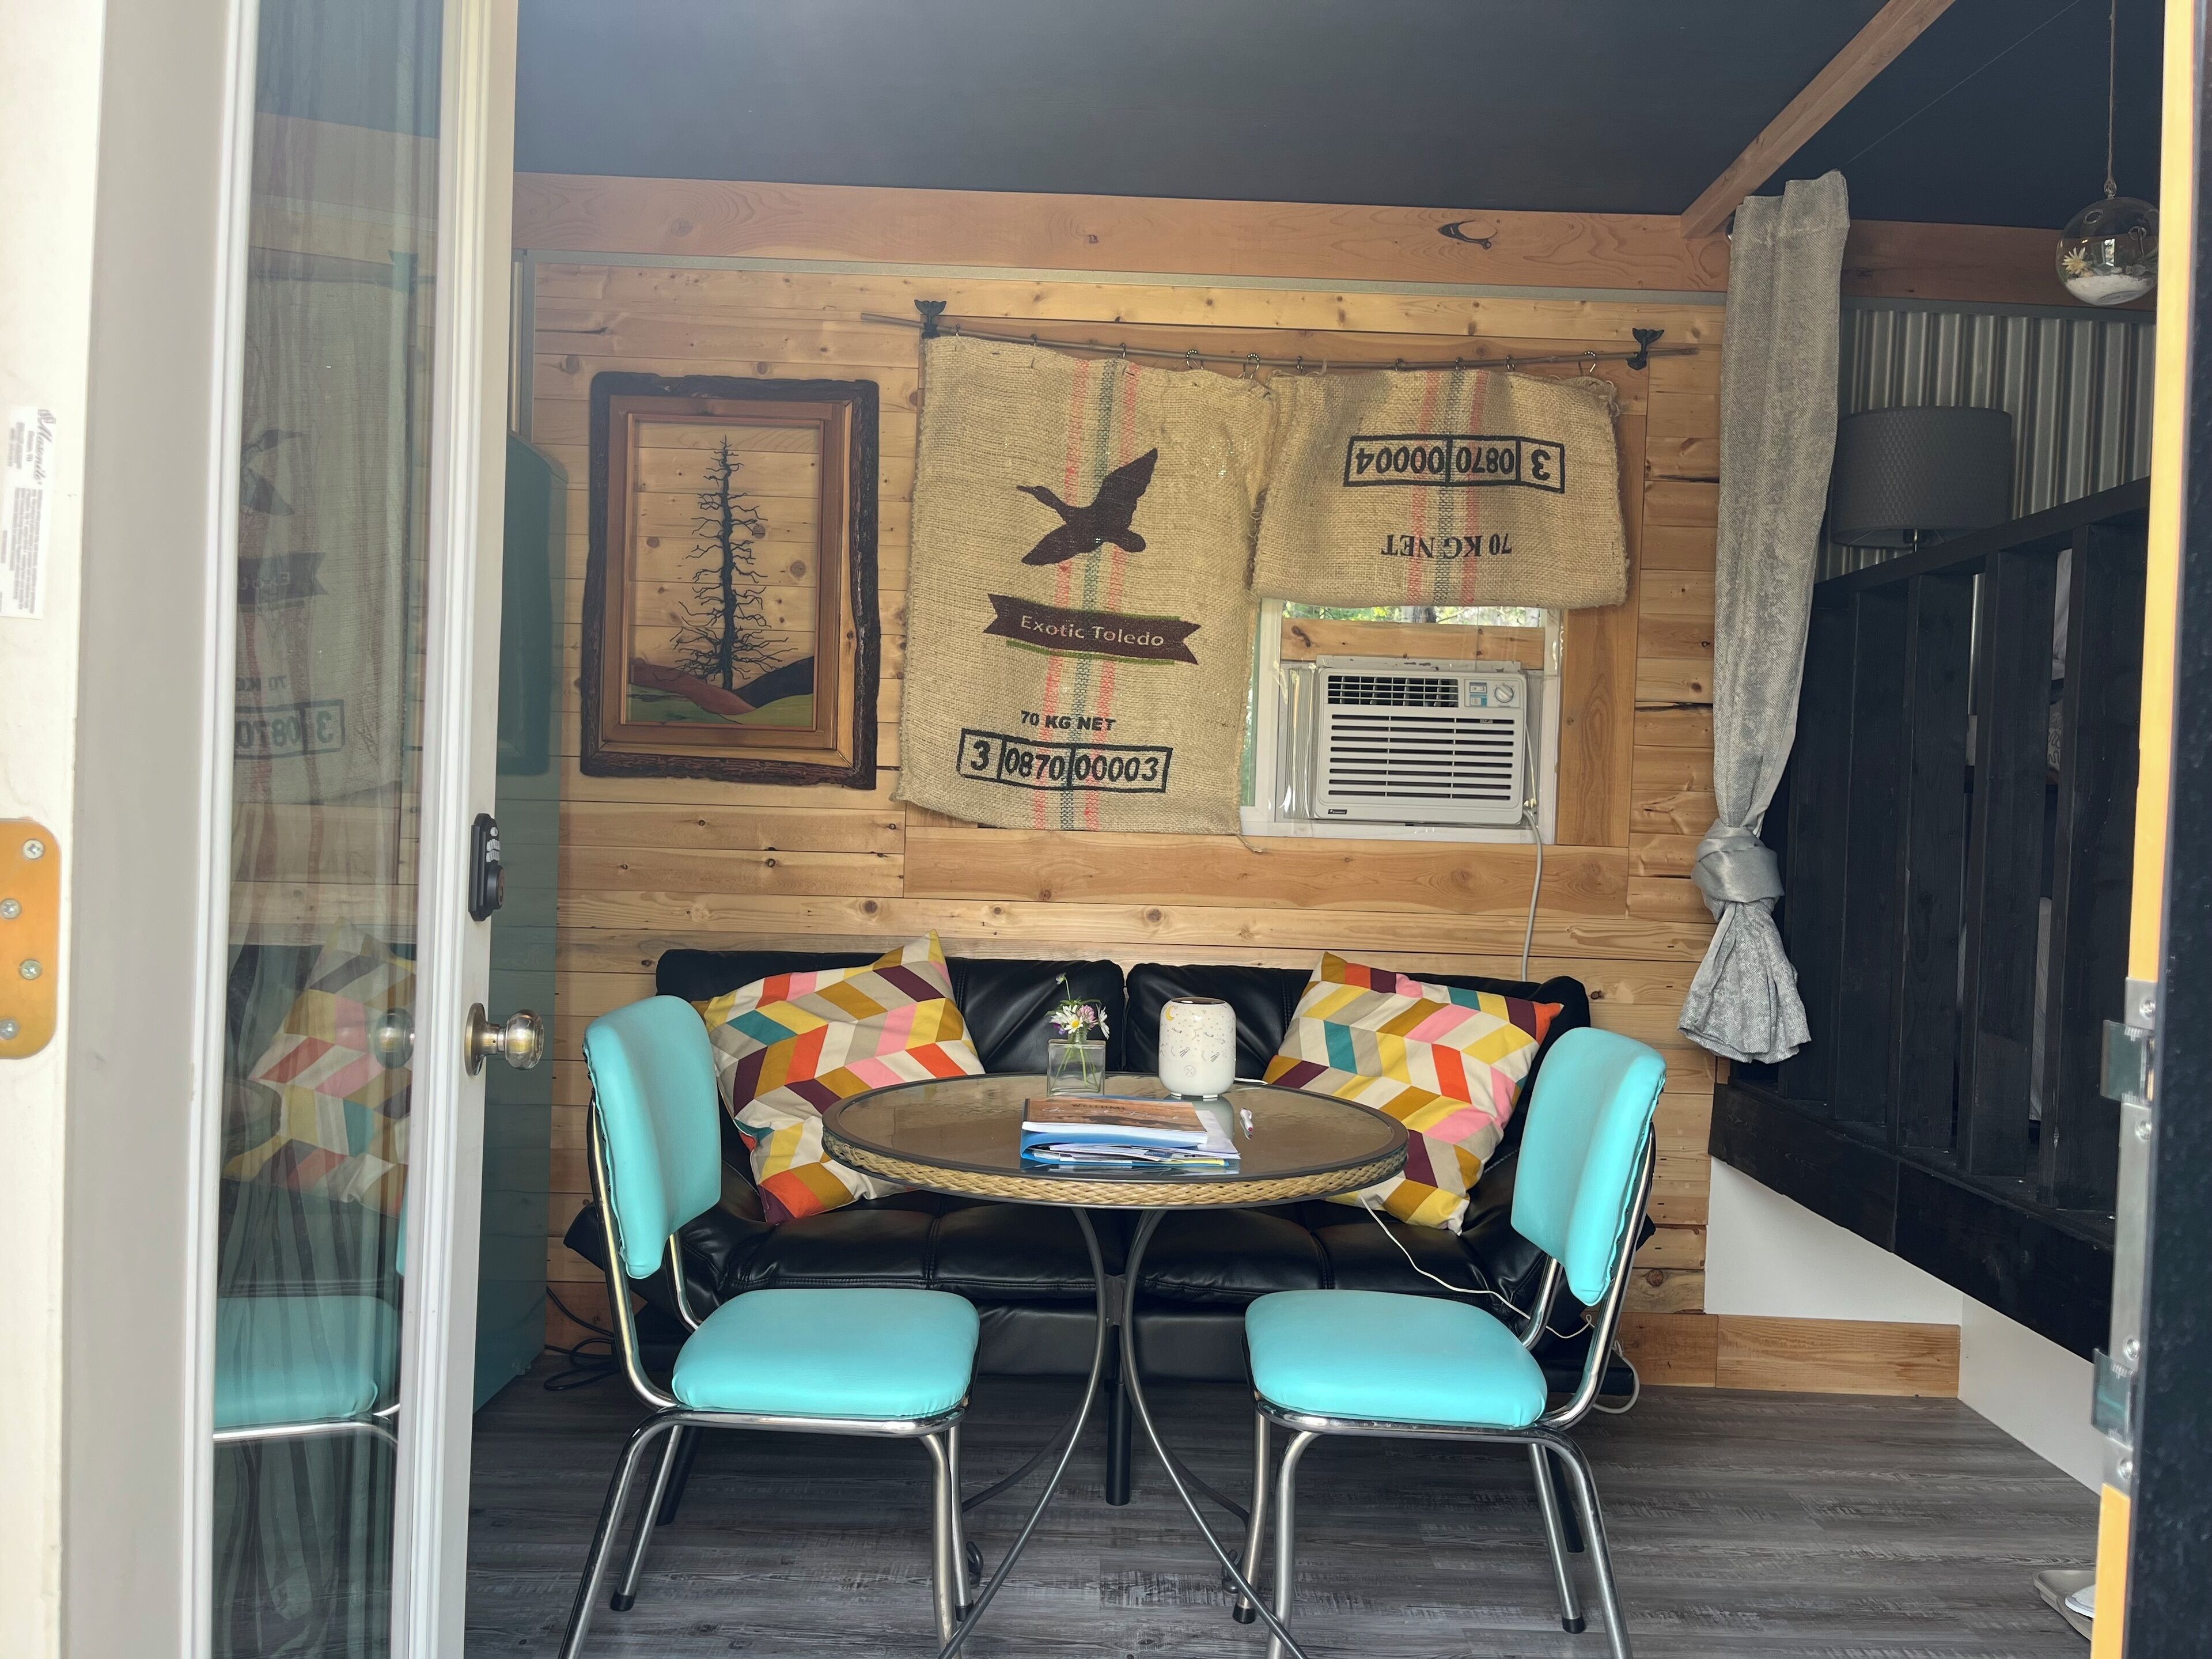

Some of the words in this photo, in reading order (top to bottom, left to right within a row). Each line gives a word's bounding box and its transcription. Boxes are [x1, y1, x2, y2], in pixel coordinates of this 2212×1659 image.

[1355, 446, 1444, 475] 00004
[1455, 447, 1515, 475] 0870
[1531, 449, 1551, 480] 3
[1381, 534, 1435, 558] NET
[1440, 535, 1483, 559] KG
[1488, 533, 1513, 556] 70
[1021, 615, 1085, 639] Exotic
[1093, 627, 1165, 647] Toledo
[1021, 710, 1040, 727] 70
[1044, 714, 1071, 730] KG
[1077, 716, 1116, 731] NET
[971, 740, 991, 771] 3
[1004, 749, 1066, 781] 0870
[1075, 756, 1159, 781] 00003
